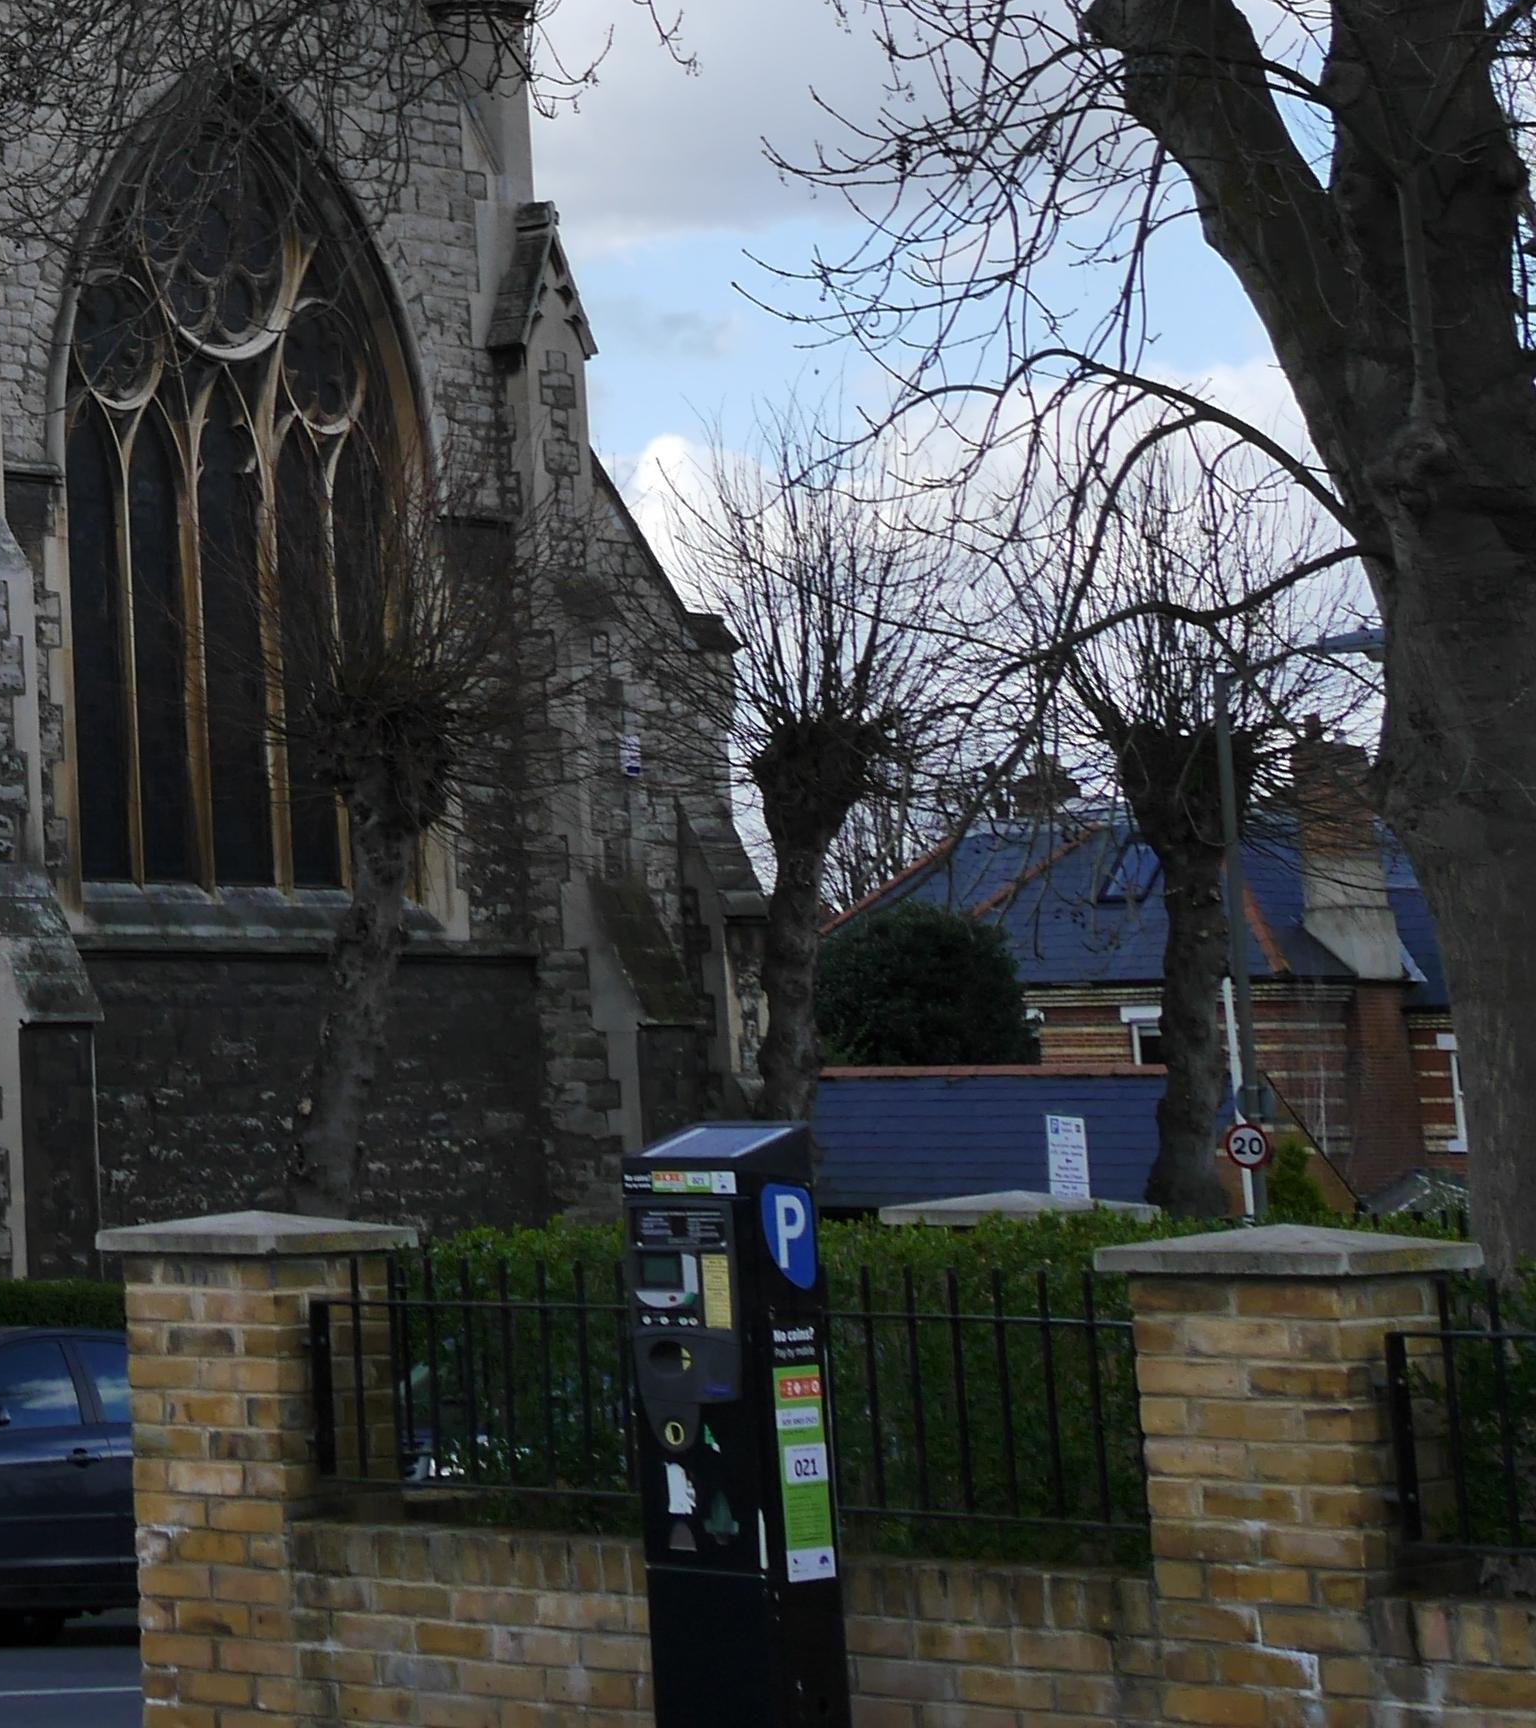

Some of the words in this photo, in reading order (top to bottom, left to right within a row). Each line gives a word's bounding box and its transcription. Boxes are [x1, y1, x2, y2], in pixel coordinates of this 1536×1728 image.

[1232, 1136, 1263, 1156] 20
[774, 1194, 806, 1269] P
[794, 1458, 818, 1477] 021
